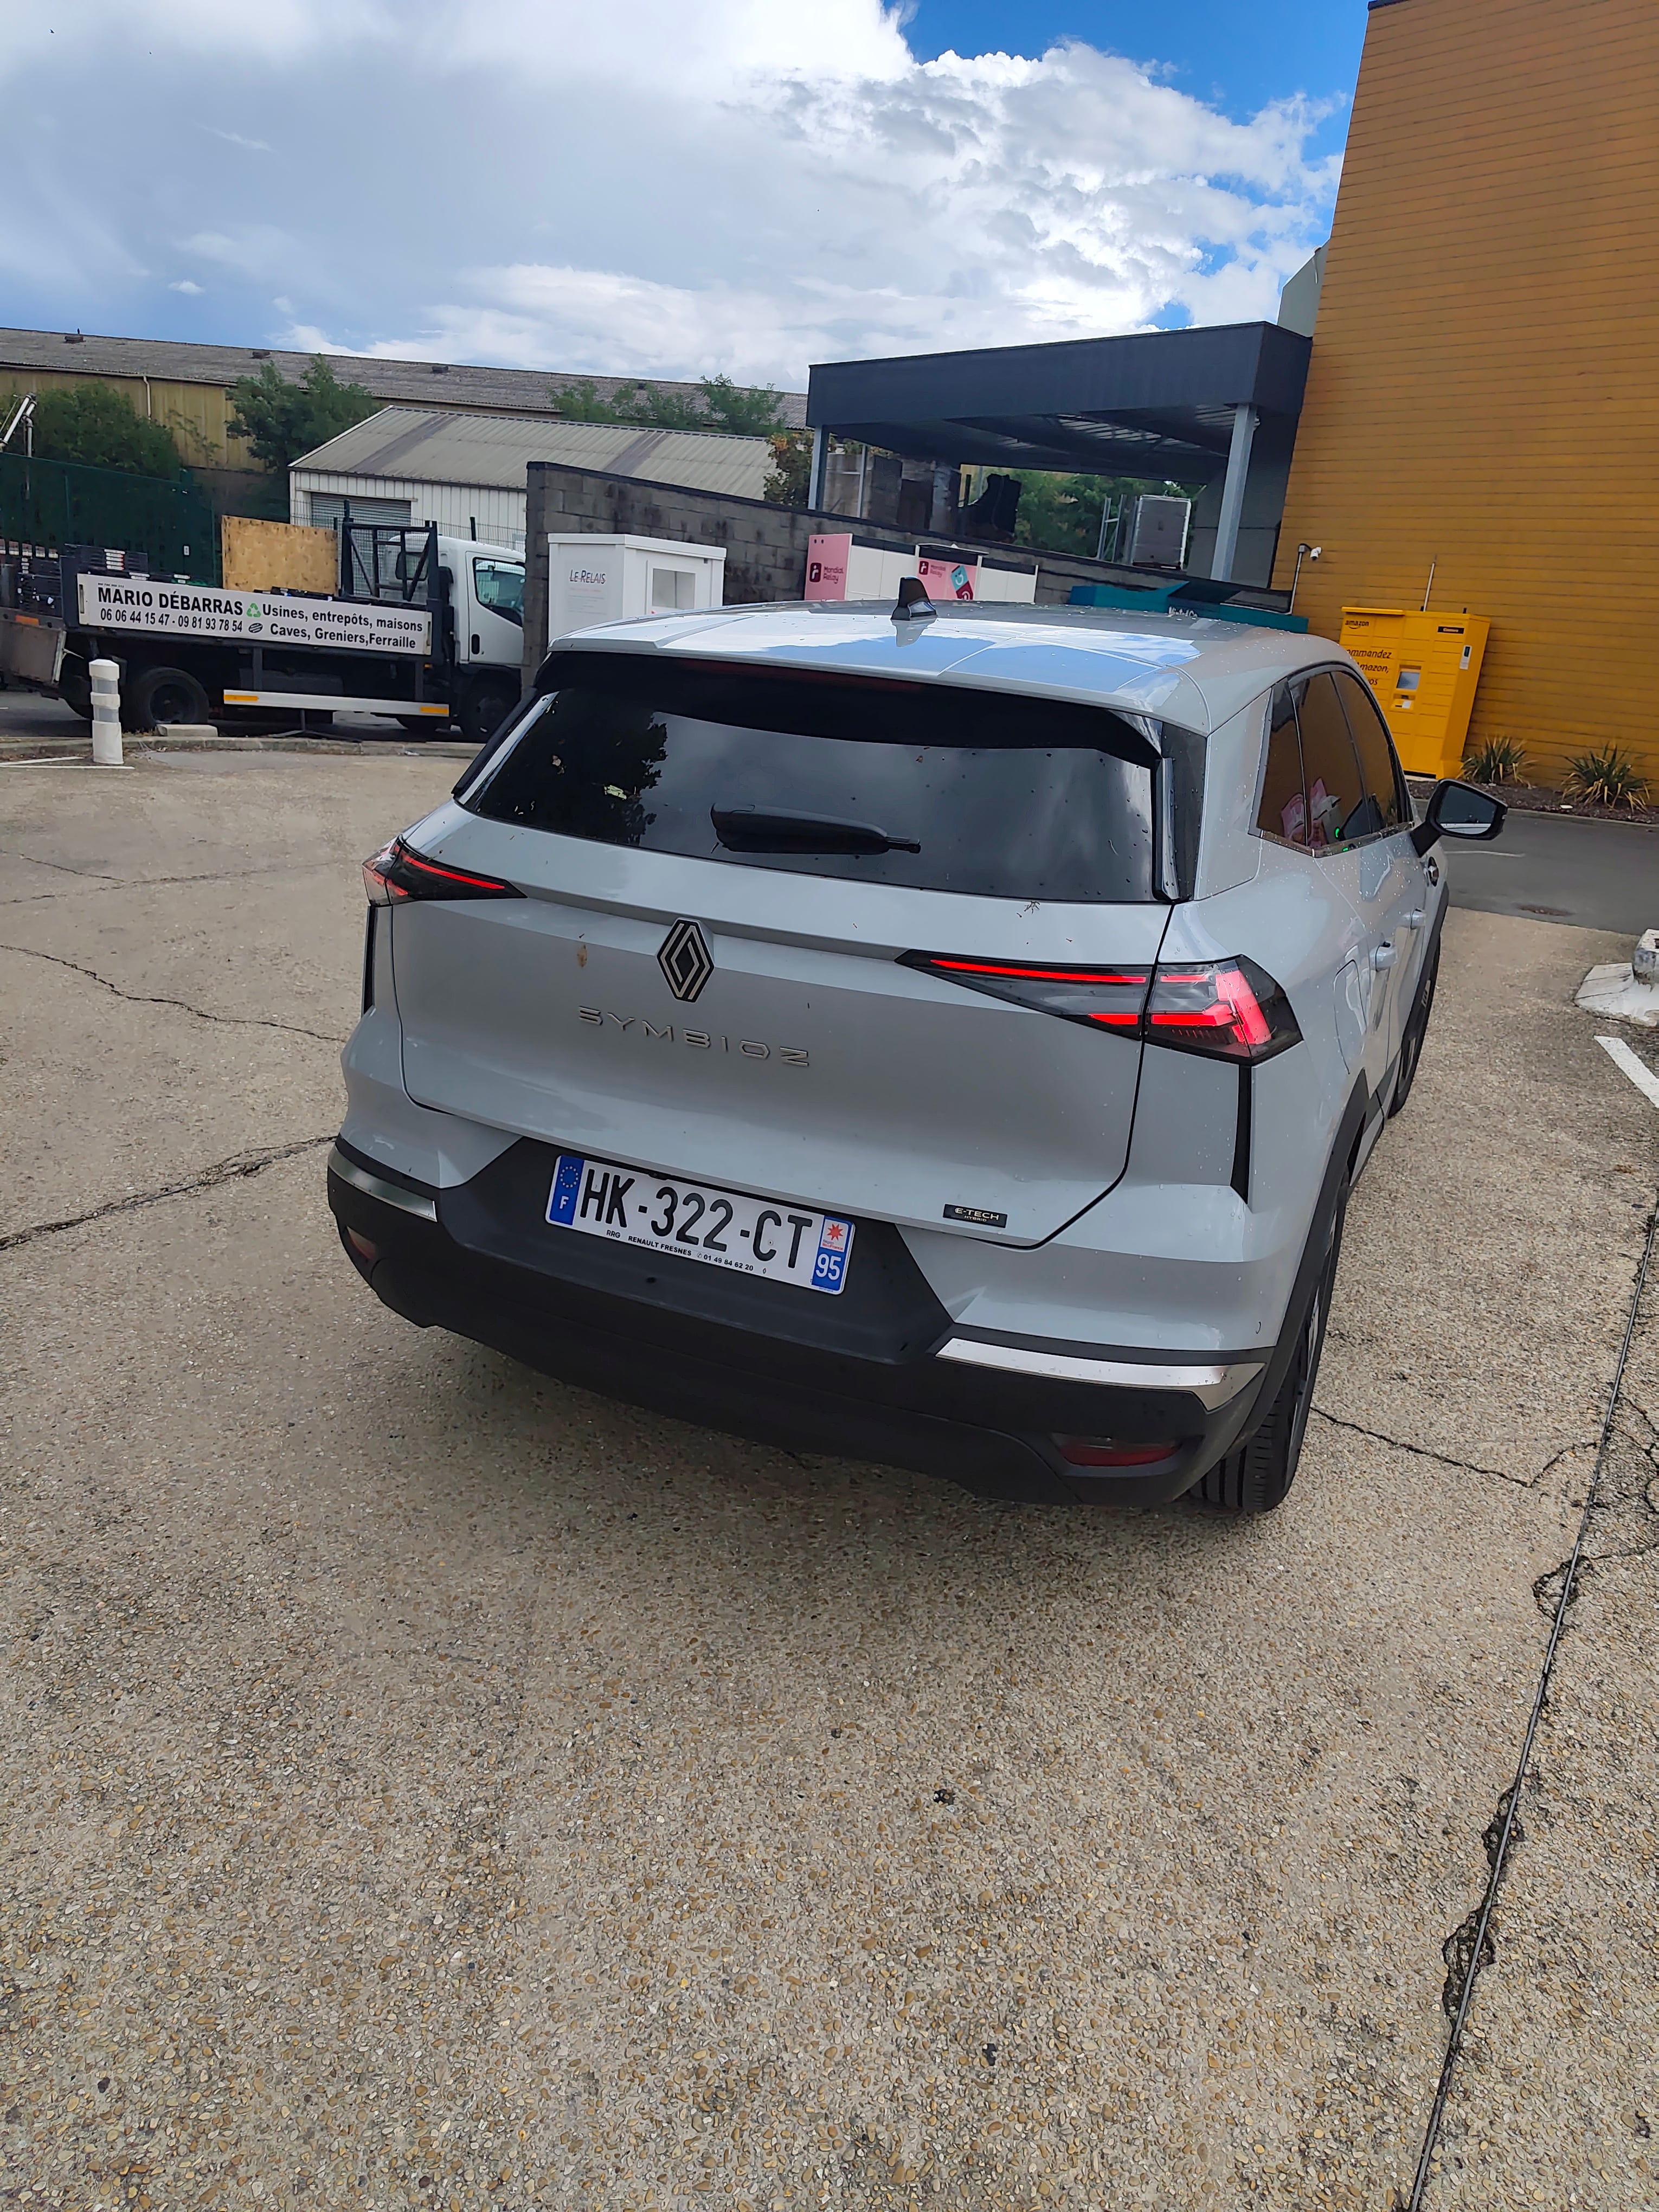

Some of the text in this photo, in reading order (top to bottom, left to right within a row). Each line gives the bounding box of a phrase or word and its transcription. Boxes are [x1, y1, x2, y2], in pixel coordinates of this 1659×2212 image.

[580, 570, 606, 584] RELAIS
[98, 587, 243, 616] MARIO DÉBARRAS
[100, 608, 112, 621] 06
[115, 609, 127, 622] 06
[130, 610, 142, 623] 44
[145, 612, 156, 625] 15
[158, 613, 170, 626] 47
[178, 615, 189, 627] 09
[192, 616, 202, 629] 81
[205, 618, 216, 630] 93
[219, 619, 229, 631] 78
[232, 620, 243, 632] 54
[262, 603, 423, 632] Usines, entrepôts, maisons
[271, 623, 311, 640] Caves,
[1346, 649, 1392, 659] ommandez
[1357, 661, 1389, 674] mazon,
[578, 1005, 809, 1067] SYMBIOZ
[559, 1168, 813, 1269] F HK-322-CT
[955, 1207, 999, 1220] E-TECH
[606, 1229, 621, 1239] RRG
[628, 1235, 659, 1248] RENAULT
[660, 1244, 692, 1256] FRESNES
[815, 1253, 841, 1281] 95
